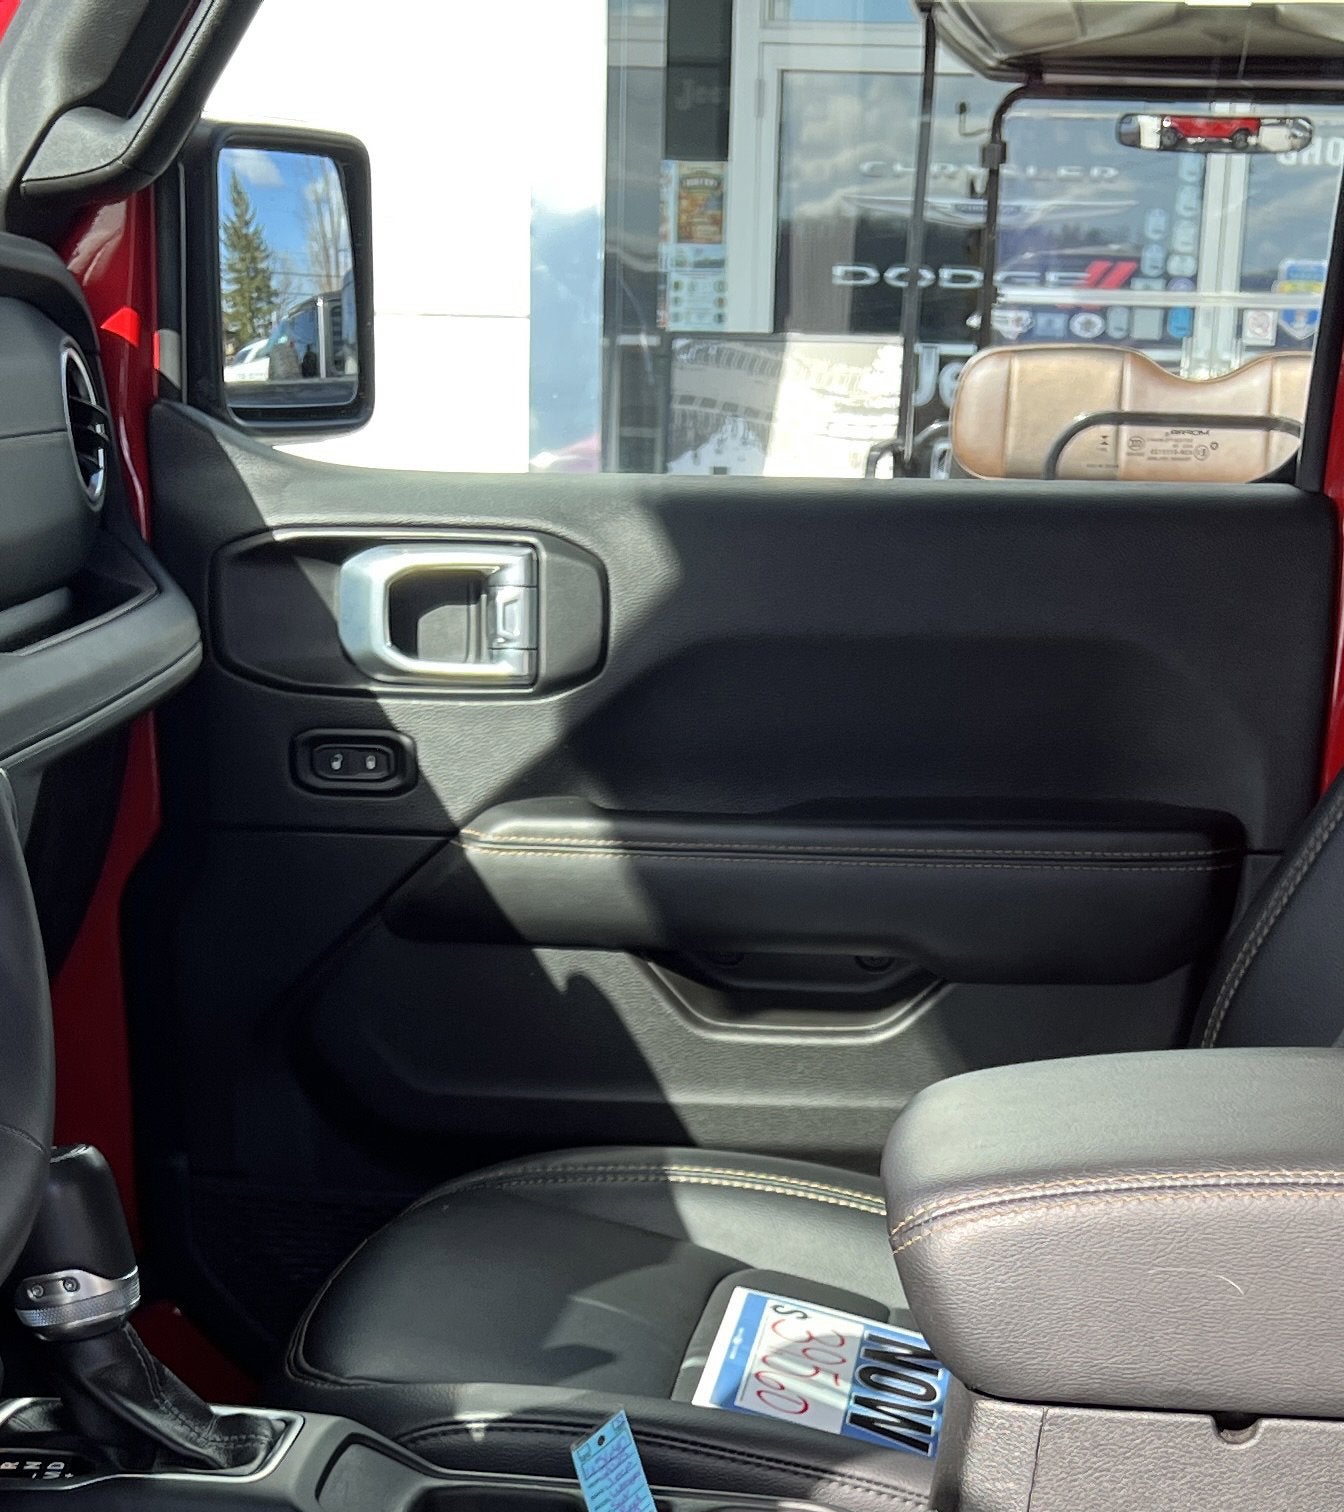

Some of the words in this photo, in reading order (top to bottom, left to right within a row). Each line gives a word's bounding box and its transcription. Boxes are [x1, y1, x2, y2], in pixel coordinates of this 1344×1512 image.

[831, 264, 1093, 288] DODGE
[848, 1331, 940, 1455] NOW
[0, 1461, 20, 1470] R
[47, 1461, 65, 1470] D
